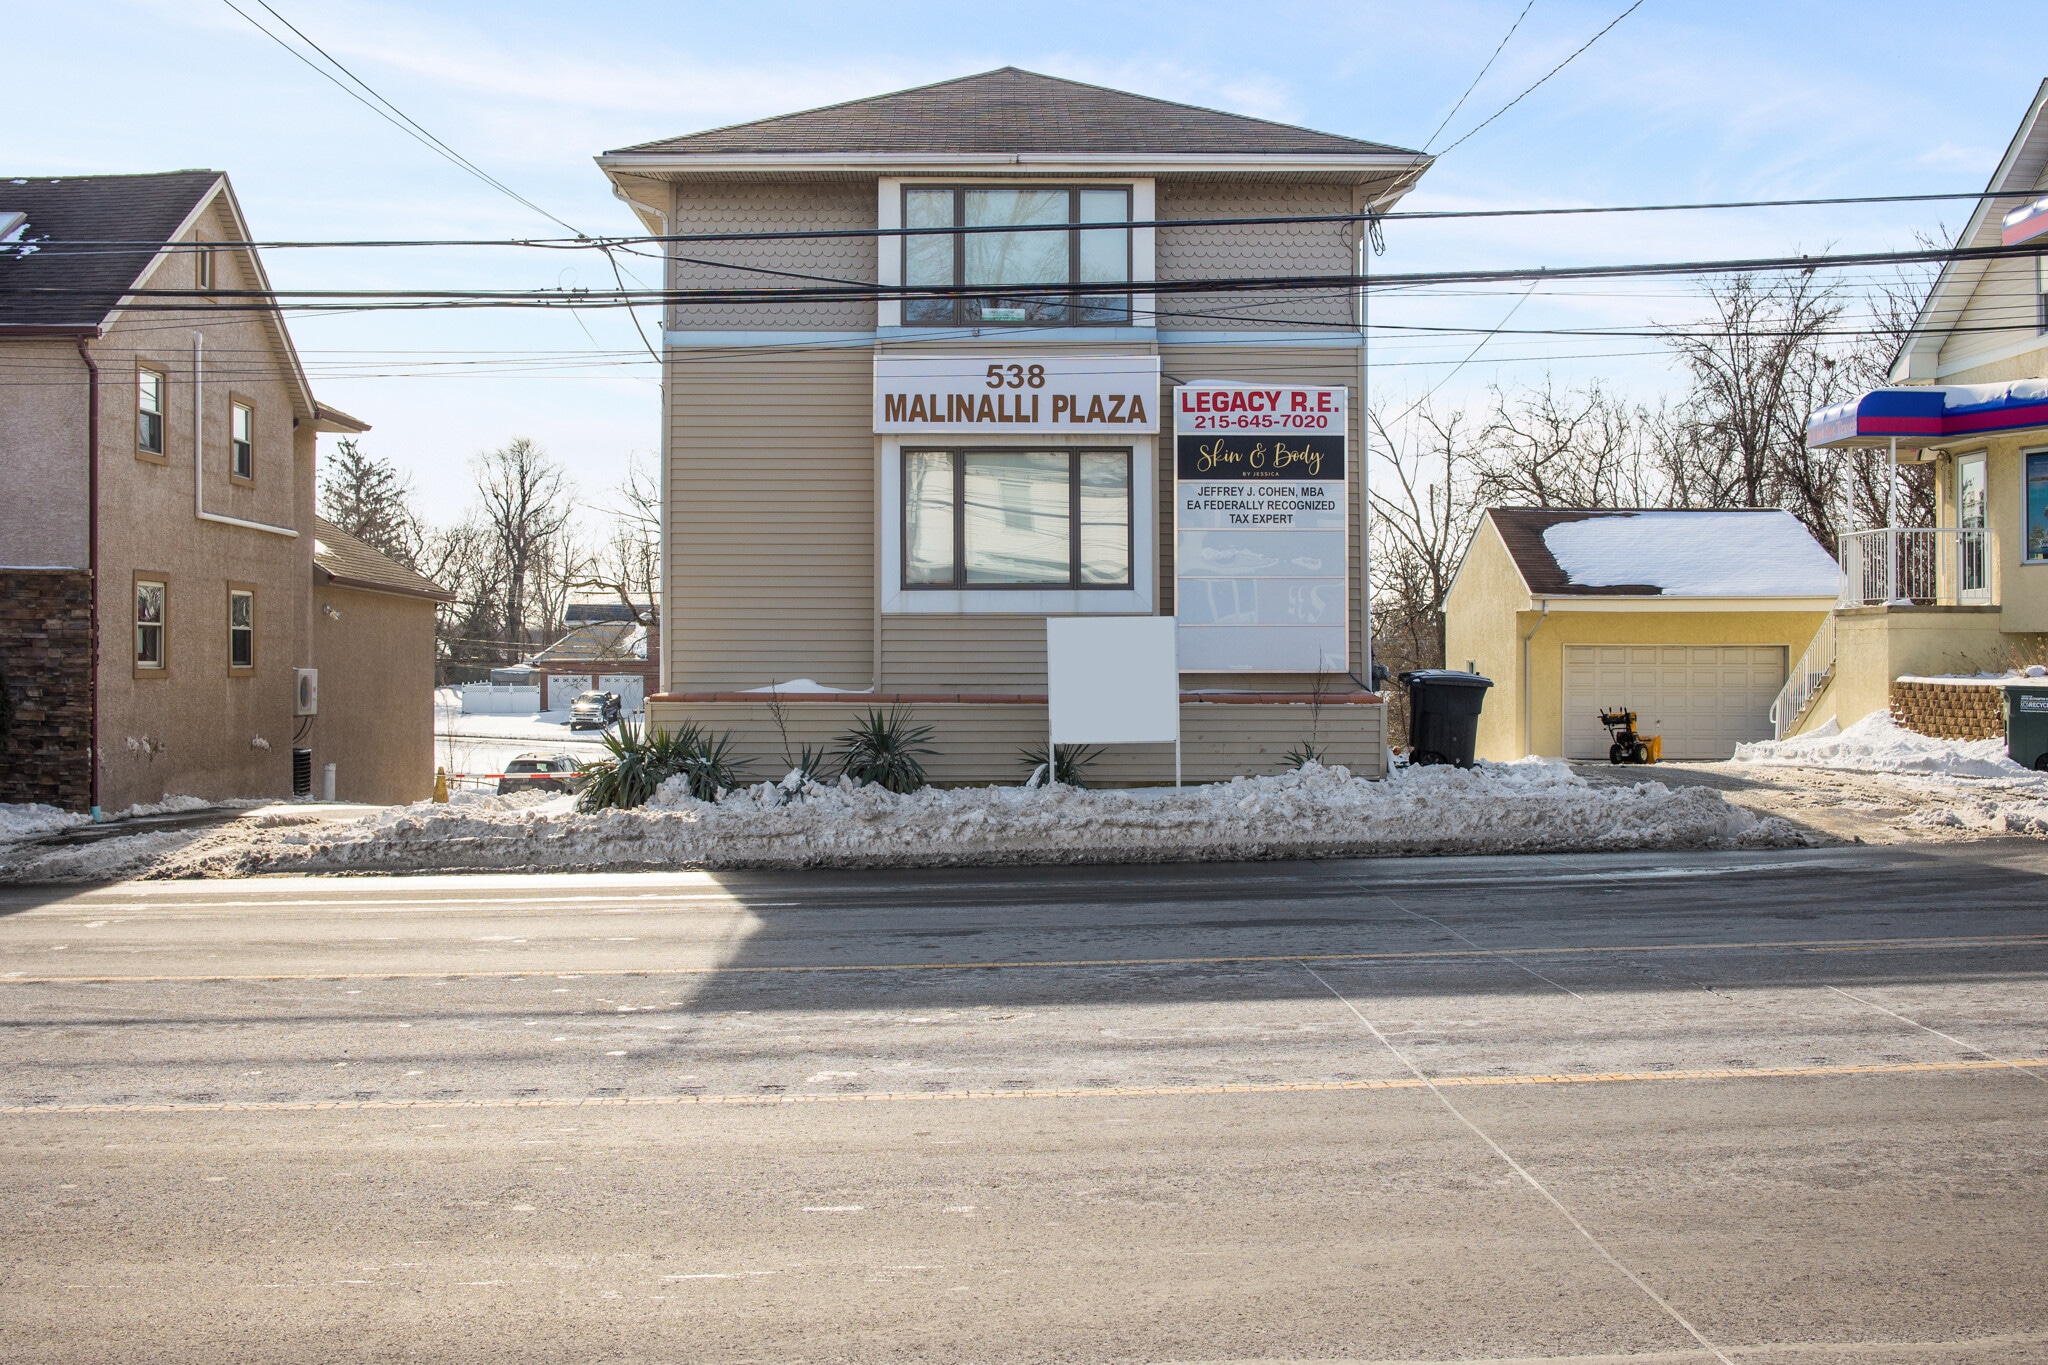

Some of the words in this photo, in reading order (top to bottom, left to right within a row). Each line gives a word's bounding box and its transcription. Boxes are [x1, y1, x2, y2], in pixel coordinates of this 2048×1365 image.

[985, 364, 1046, 389] 538
[884, 393, 1039, 423] MALINALLI
[1052, 394, 1147, 424] PLAZA
[1182, 391, 1282, 412] LEGACY
[1291, 391, 1339, 412] R.E.
[1194, 414, 1328, 429] 215-645-7020
[1197, 438, 1243, 472] Skin
[1250, 442, 1266, 469] &
[1273, 442, 1324, 475] Body
[1197, 486, 1245, 497] JEFFREY
[1246, 486, 1256, 497] J.
[1258, 486, 1298, 499] COHEN,
[1301, 487, 1325, 497] MBA
[1187, 501, 1201, 510] EA
[1203, 500, 1265, 511] FEDERALLY
[1267, 500, 1336, 511] RECOGNIZED
[1229, 514, 1250, 524] TAX
[1252, 514, 1294, 524] EXPERT
